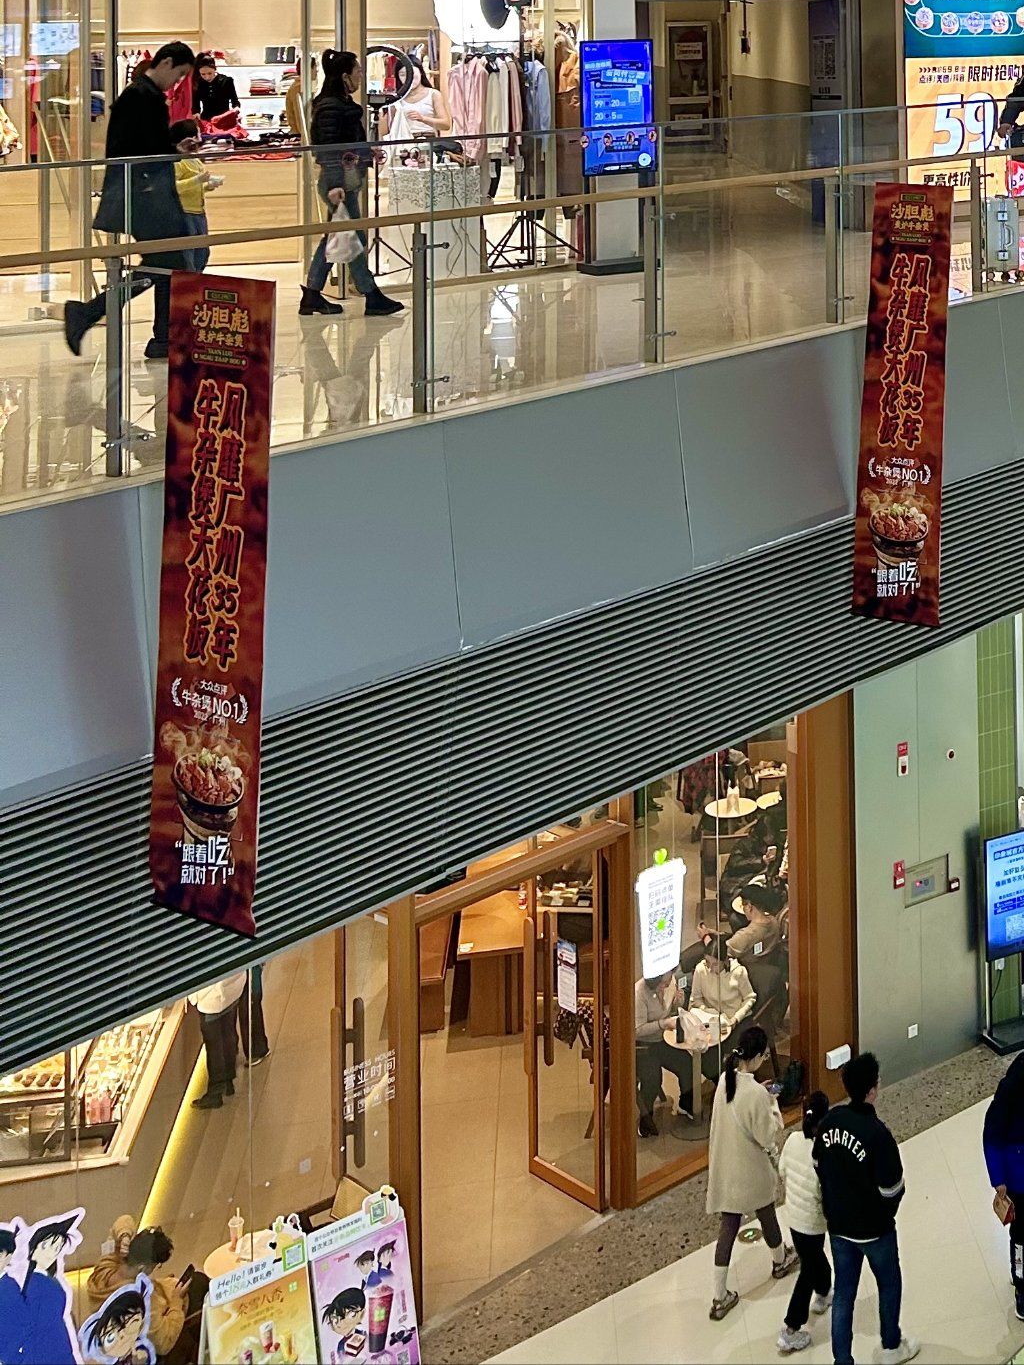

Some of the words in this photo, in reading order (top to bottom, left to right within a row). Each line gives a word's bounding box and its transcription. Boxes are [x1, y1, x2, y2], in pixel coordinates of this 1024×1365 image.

[891, 204, 934, 222] 沙胆彪
[192, 305, 250, 333] 沙胆彪
[184, 378, 221, 665] 牛杂煲天花板
[211, 381, 248, 672] 风靡广州35年
[199, 679, 228, 695] 大众点评
[181, 690, 239, 720] 牛杂煲NO.1
[344, 1057, 395, 1090] 营业时间
[822, 1128, 866, 1162] STARTER
[216, 1268, 246, 1290] Hello!
